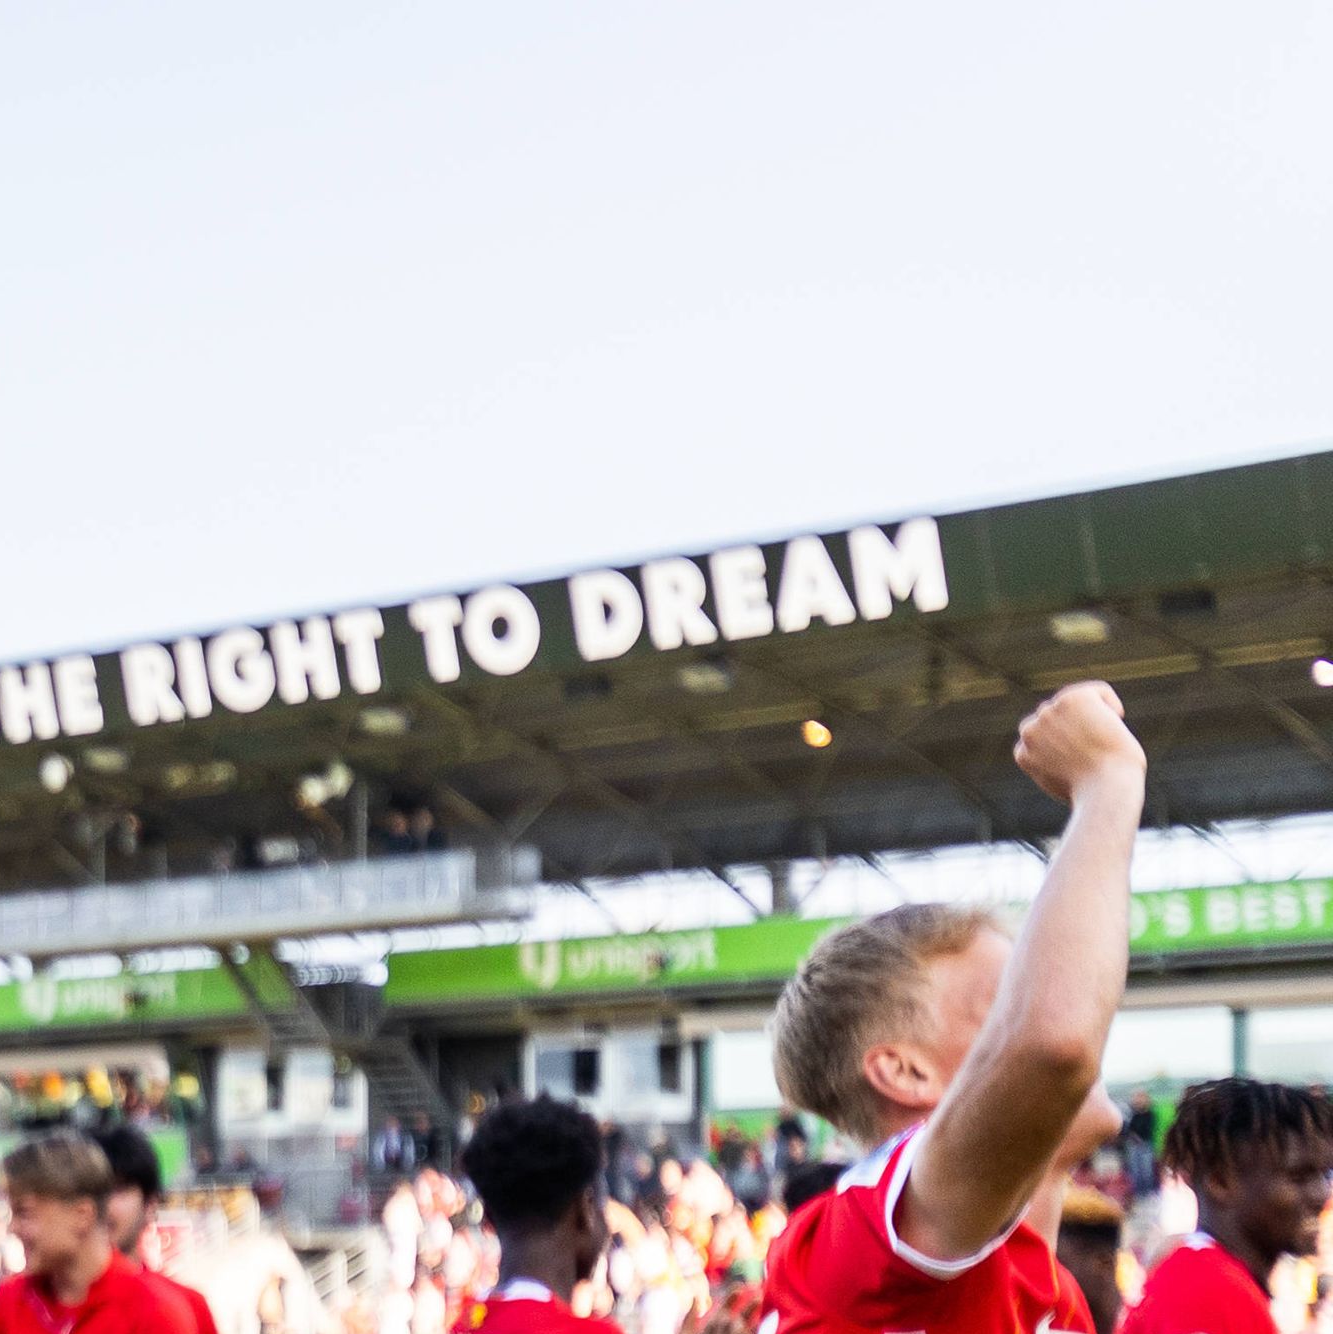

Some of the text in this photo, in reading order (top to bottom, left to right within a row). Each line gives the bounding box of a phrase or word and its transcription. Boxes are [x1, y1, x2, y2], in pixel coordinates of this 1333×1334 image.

[120, 606, 383, 727] RIGHT
[408, 583, 541, 683] TO
[567, 516, 949, 663] DREAM
[1204, 882, 1330, 934] BEST
